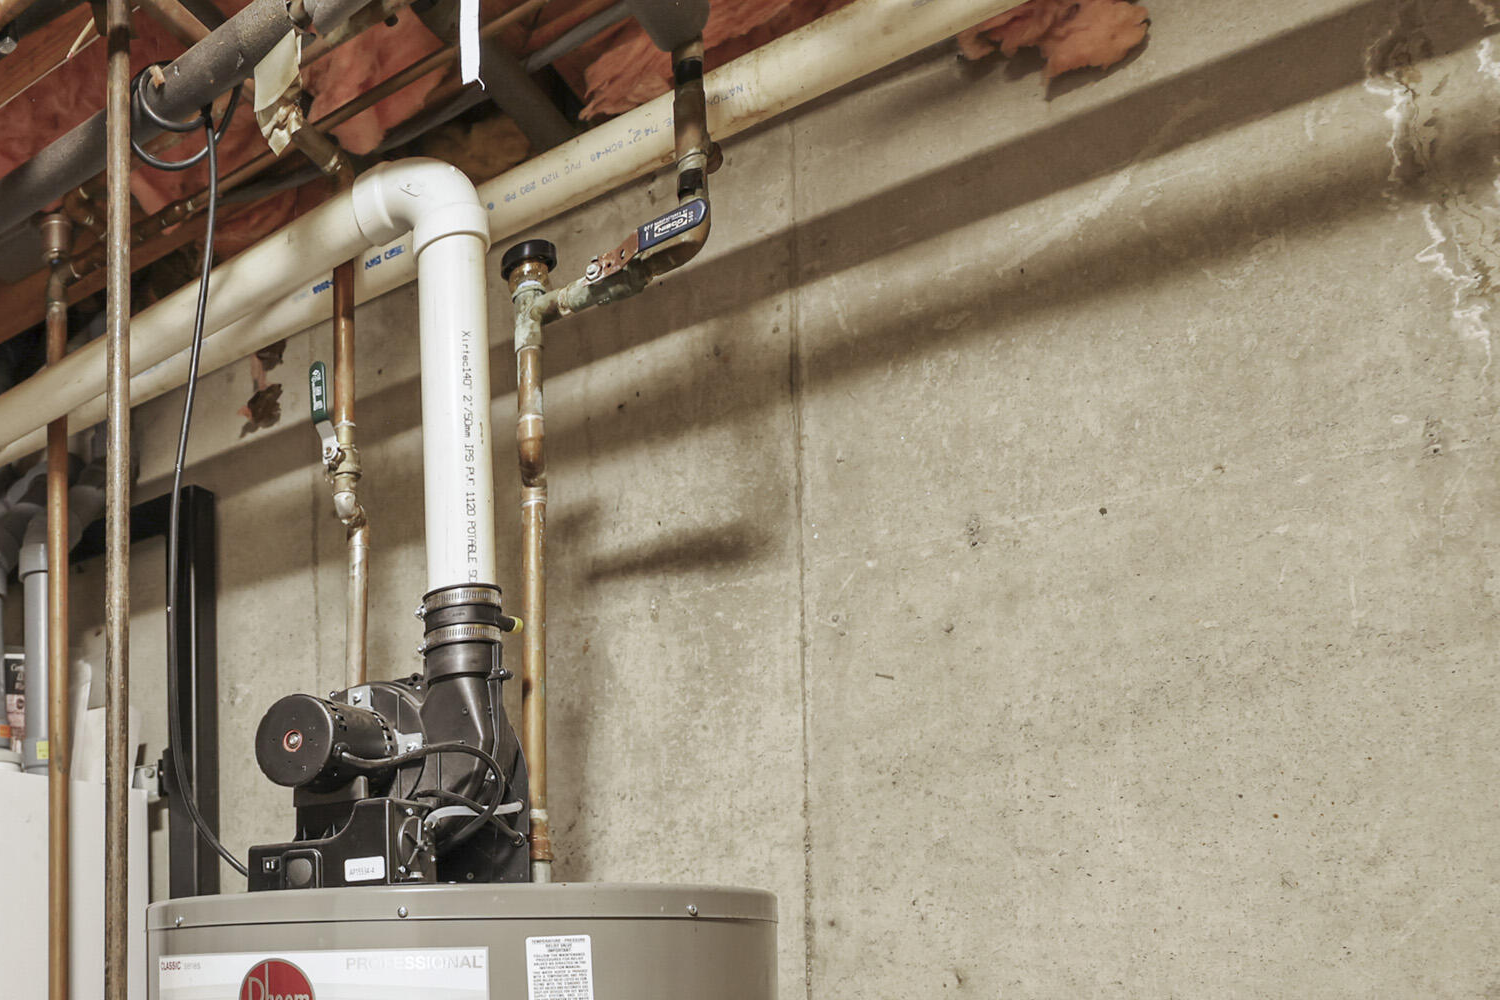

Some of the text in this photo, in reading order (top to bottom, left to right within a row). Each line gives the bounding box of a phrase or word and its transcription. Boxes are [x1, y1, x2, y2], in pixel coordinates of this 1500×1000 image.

[464, 444, 475, 462] IPS
[466, 492, 476, 516] 1120
[467, 520, 477, 563] POTABLE
[160, 960, 181, 970] CLASSIC
